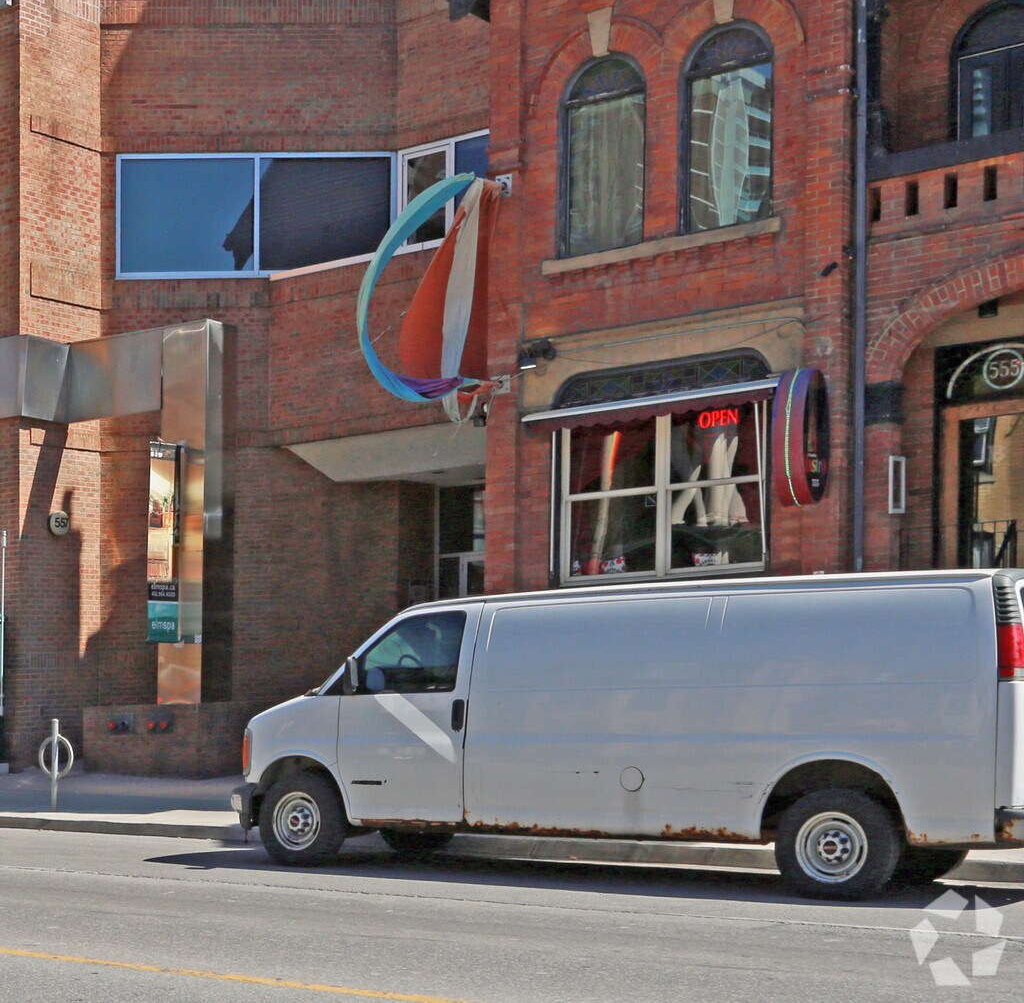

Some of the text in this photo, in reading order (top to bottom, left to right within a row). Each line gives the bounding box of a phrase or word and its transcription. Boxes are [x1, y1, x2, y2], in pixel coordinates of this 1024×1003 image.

[989, 359, 1020, 379] 555
[698, 407, 739, 429] OPEN
[55, 517, 69, 528] 557
[151, 582, 175, 591] elmspa.ca
[152, 618, 175, 632] elmspa
